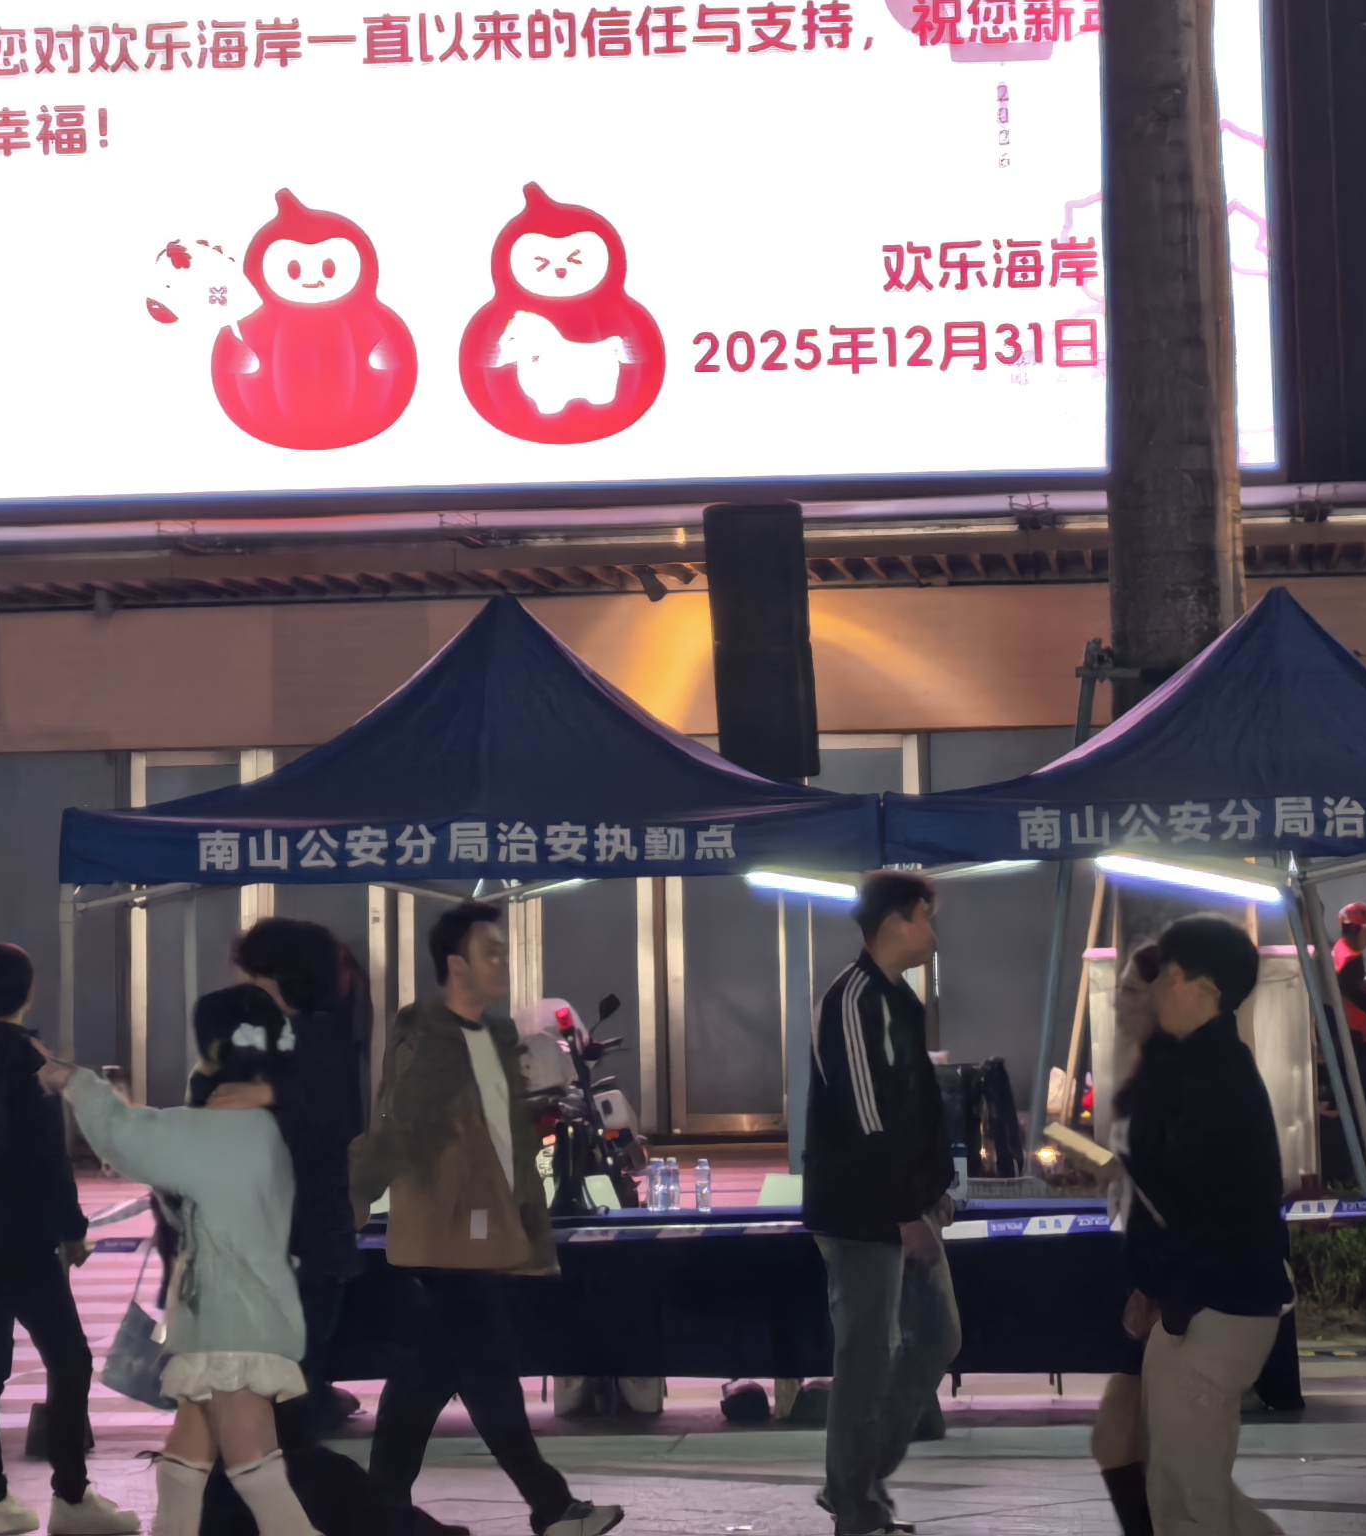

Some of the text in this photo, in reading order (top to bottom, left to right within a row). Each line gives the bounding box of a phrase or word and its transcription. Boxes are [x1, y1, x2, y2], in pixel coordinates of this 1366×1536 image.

[881, 236, 1099, 293] 欢乐海岸
[692, 318, 1099, 375] 2025年12月31日
[197, 821, 736, 871] 南山公安分局治安执勤点
